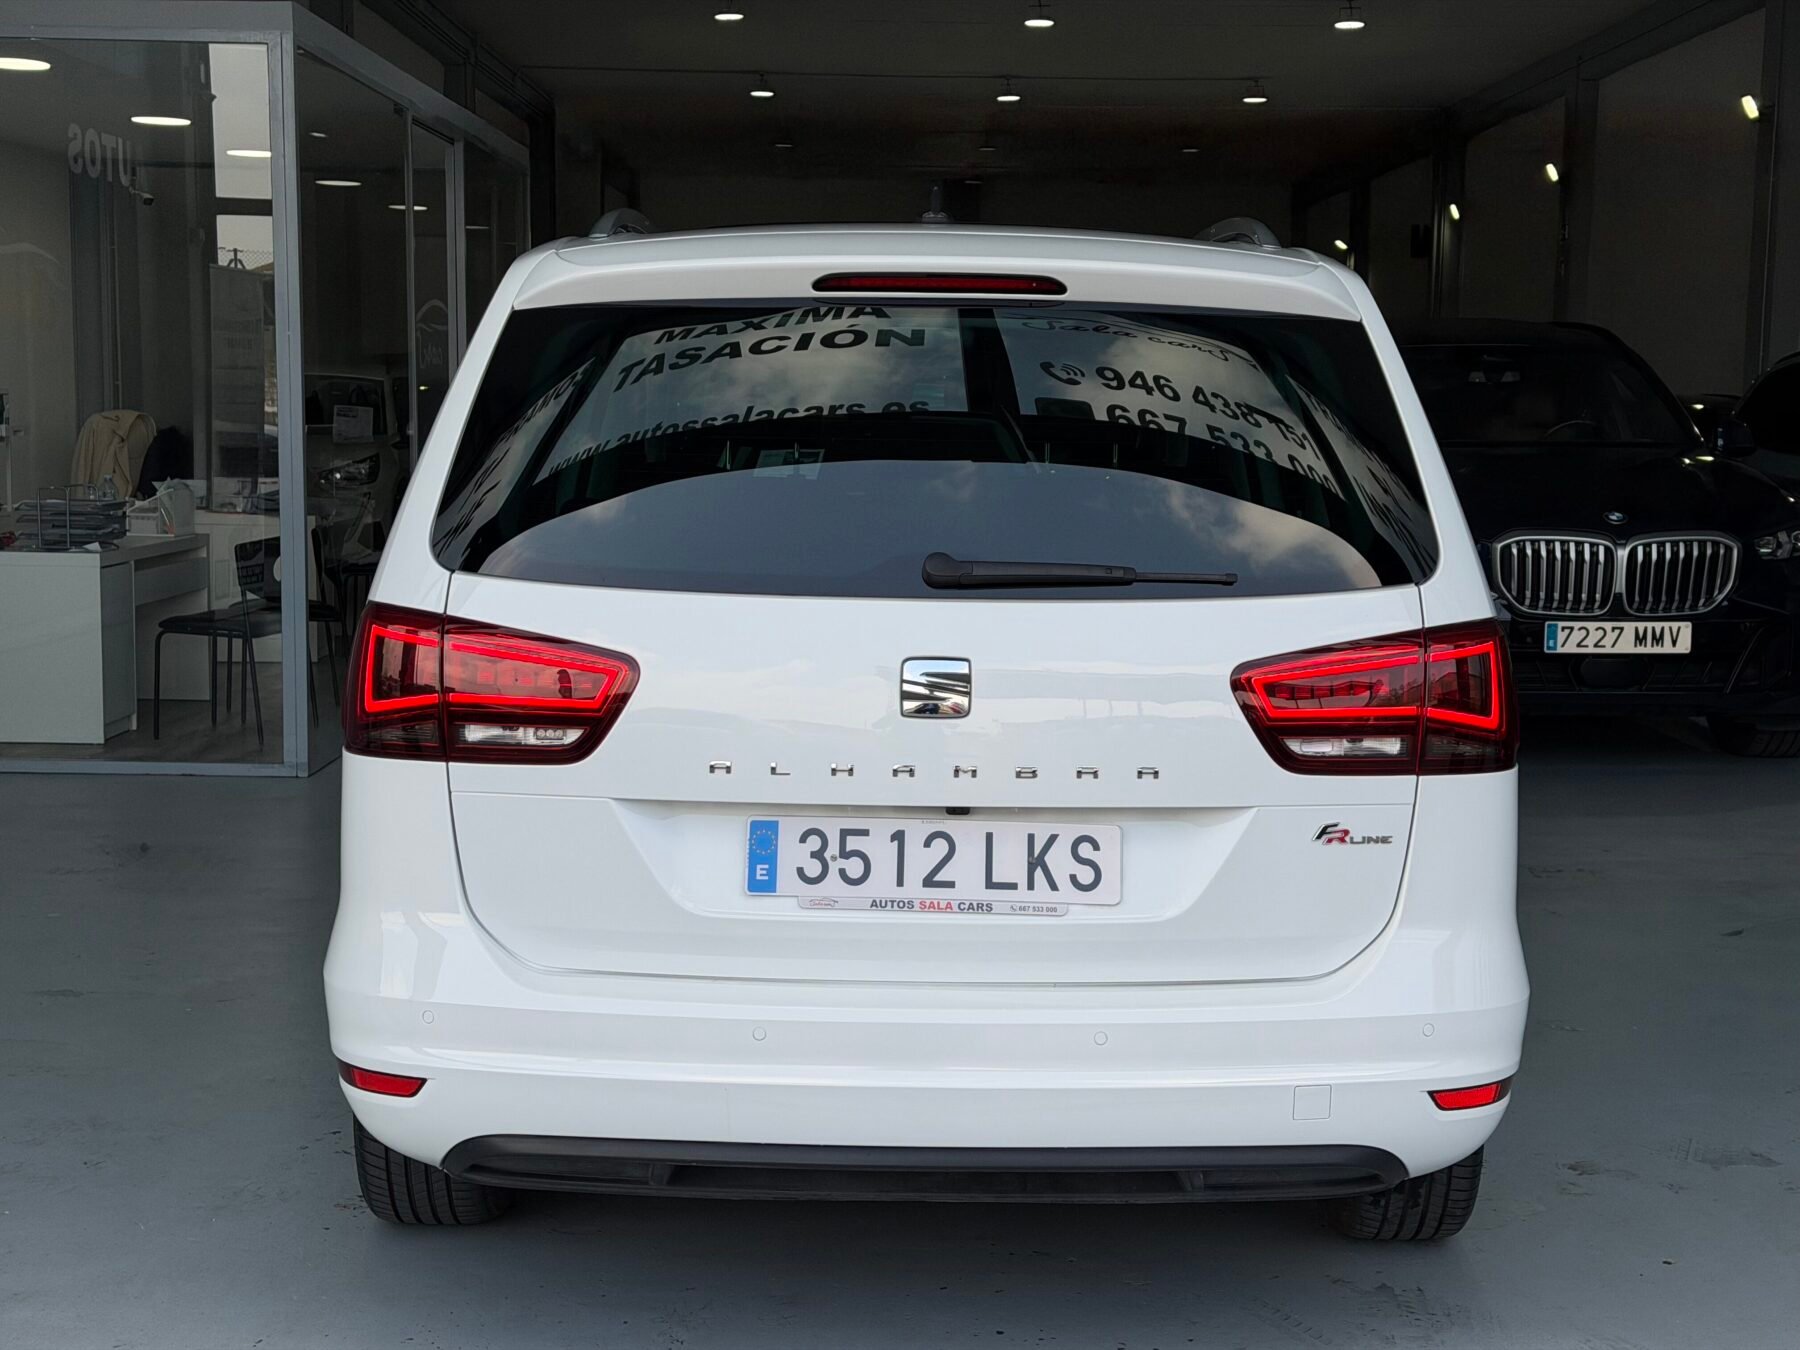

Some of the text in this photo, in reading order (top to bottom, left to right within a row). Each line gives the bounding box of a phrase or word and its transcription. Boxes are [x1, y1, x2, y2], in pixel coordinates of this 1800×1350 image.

[654, 306, 891, 344] MAXIMA
[613, 323, 925, 393] TASACIÓN
[1095, 366, 1181, 401] 946
[1192, 386, 1263, 428] 438
[1560, 626, 1625, 648] 7227
[1634, 626, 1682, 648] MMV
[708, 760, 1160, 780] ALHAMBRA
[755, 863, 770, 881] E
[795, 827, 1103, 893] 3512 LKS
[869, 899, 915, 911] AUTOS
[918, 900, 954, 912] SALA
[957, 901, 994, 913] CARS
